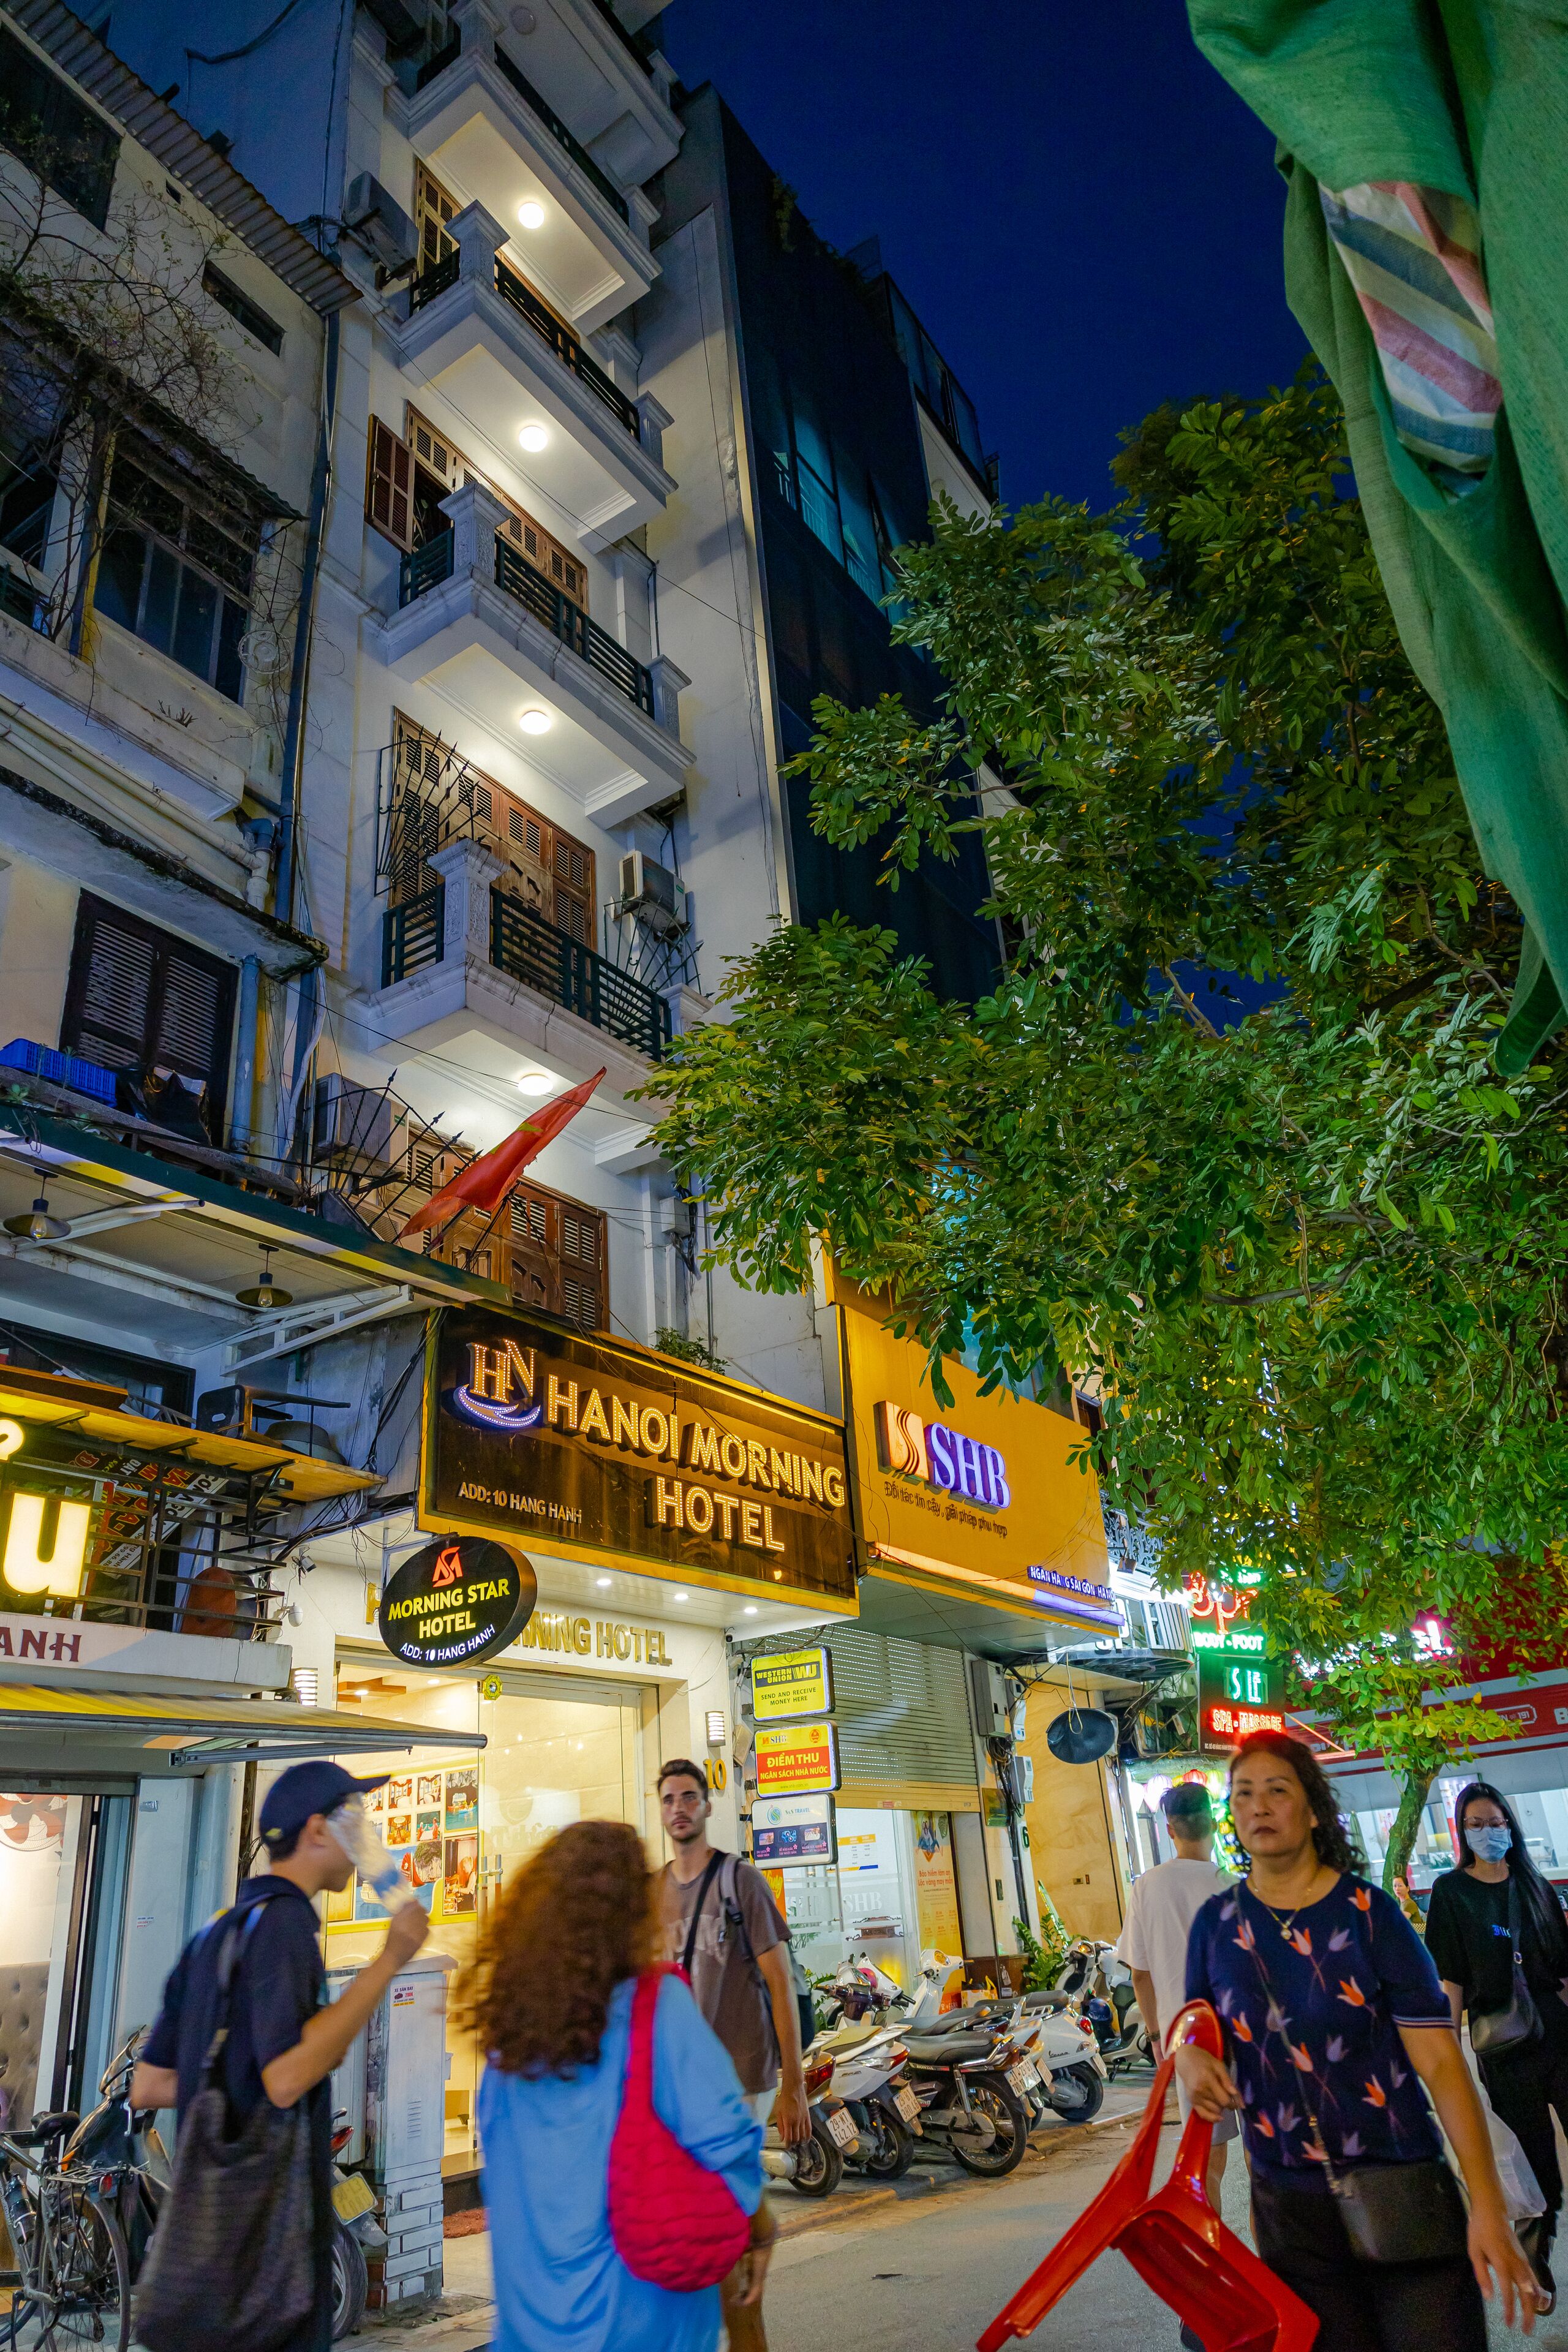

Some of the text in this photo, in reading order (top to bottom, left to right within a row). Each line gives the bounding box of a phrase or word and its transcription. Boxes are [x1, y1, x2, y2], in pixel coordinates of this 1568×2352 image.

[548, 1374, 845, 1508] HANOI MORNING
[931, 1422, 1011, 1509] SHB
[458, 1482, 582, 1525] ADD: 10 HANG HANH
[657, 1476, 785, 1552] HOTEL
[388, 1588, 464, 1621] MORNING
[467, 1578, 510, 1604] STAR
[418, 1611, 477, 1640] HOTEL
[399, 1624, 496, 1662] ADD: 10 HANG HANH
[596, 1621, 673, 1667] HOTEL
[1193, 1631, 1264, 1651] BODY FOOT
[756, 1664, 818, 1679] WESTERN WU
[767, 1674, 793, 1684] UNION
[1212, 1708, 1234, 1733] SPA
[770, 1735, 787, 1744] SHB
[766, 1752, 820, 1768] ĐIỂM THU
[703, 1758, 727, 1790] 10
[760, 1766, 828, 1780] NGÂN SÁCH NHÀ NƯỚC
[1021, 1826, 1030, 1848] 6
[843, 1891, 882, 1913] SHB
[835, 2122, 858, 2144] 142.12
